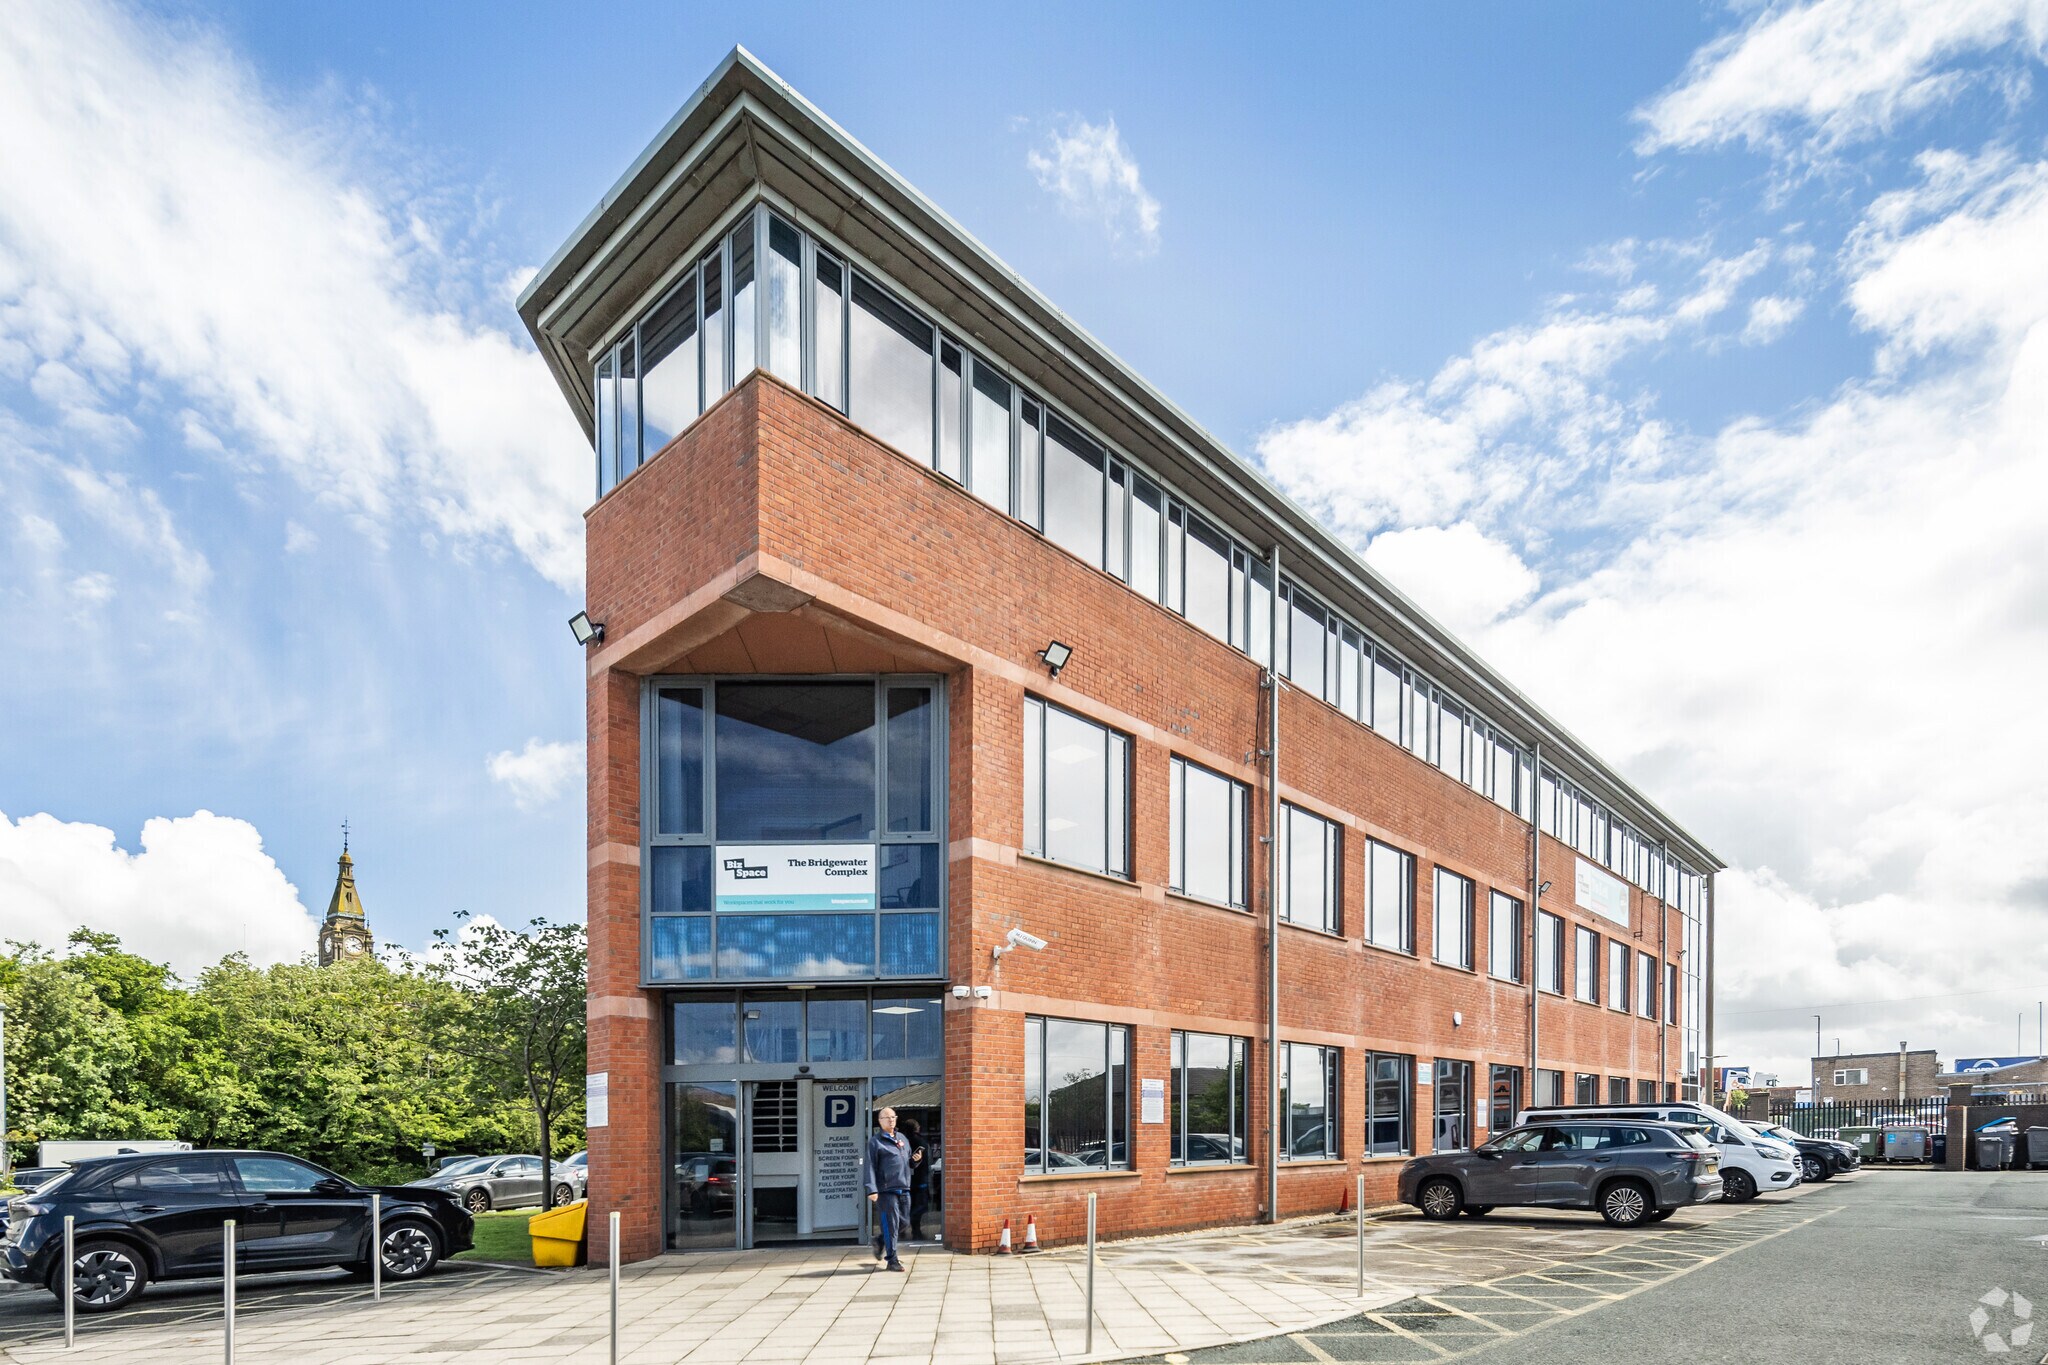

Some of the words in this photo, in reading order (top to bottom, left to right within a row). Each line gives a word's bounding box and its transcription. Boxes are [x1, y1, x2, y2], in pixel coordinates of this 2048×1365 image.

[726, 860, 743, 869] Biz
[787, 859, 807, 867] The
[808, 859, 868, 868] Bridgewater
[736, 869, 766, 878] Space
[825, 868, 868, 877] Complex
[831, 1099, 849, 1123] P
